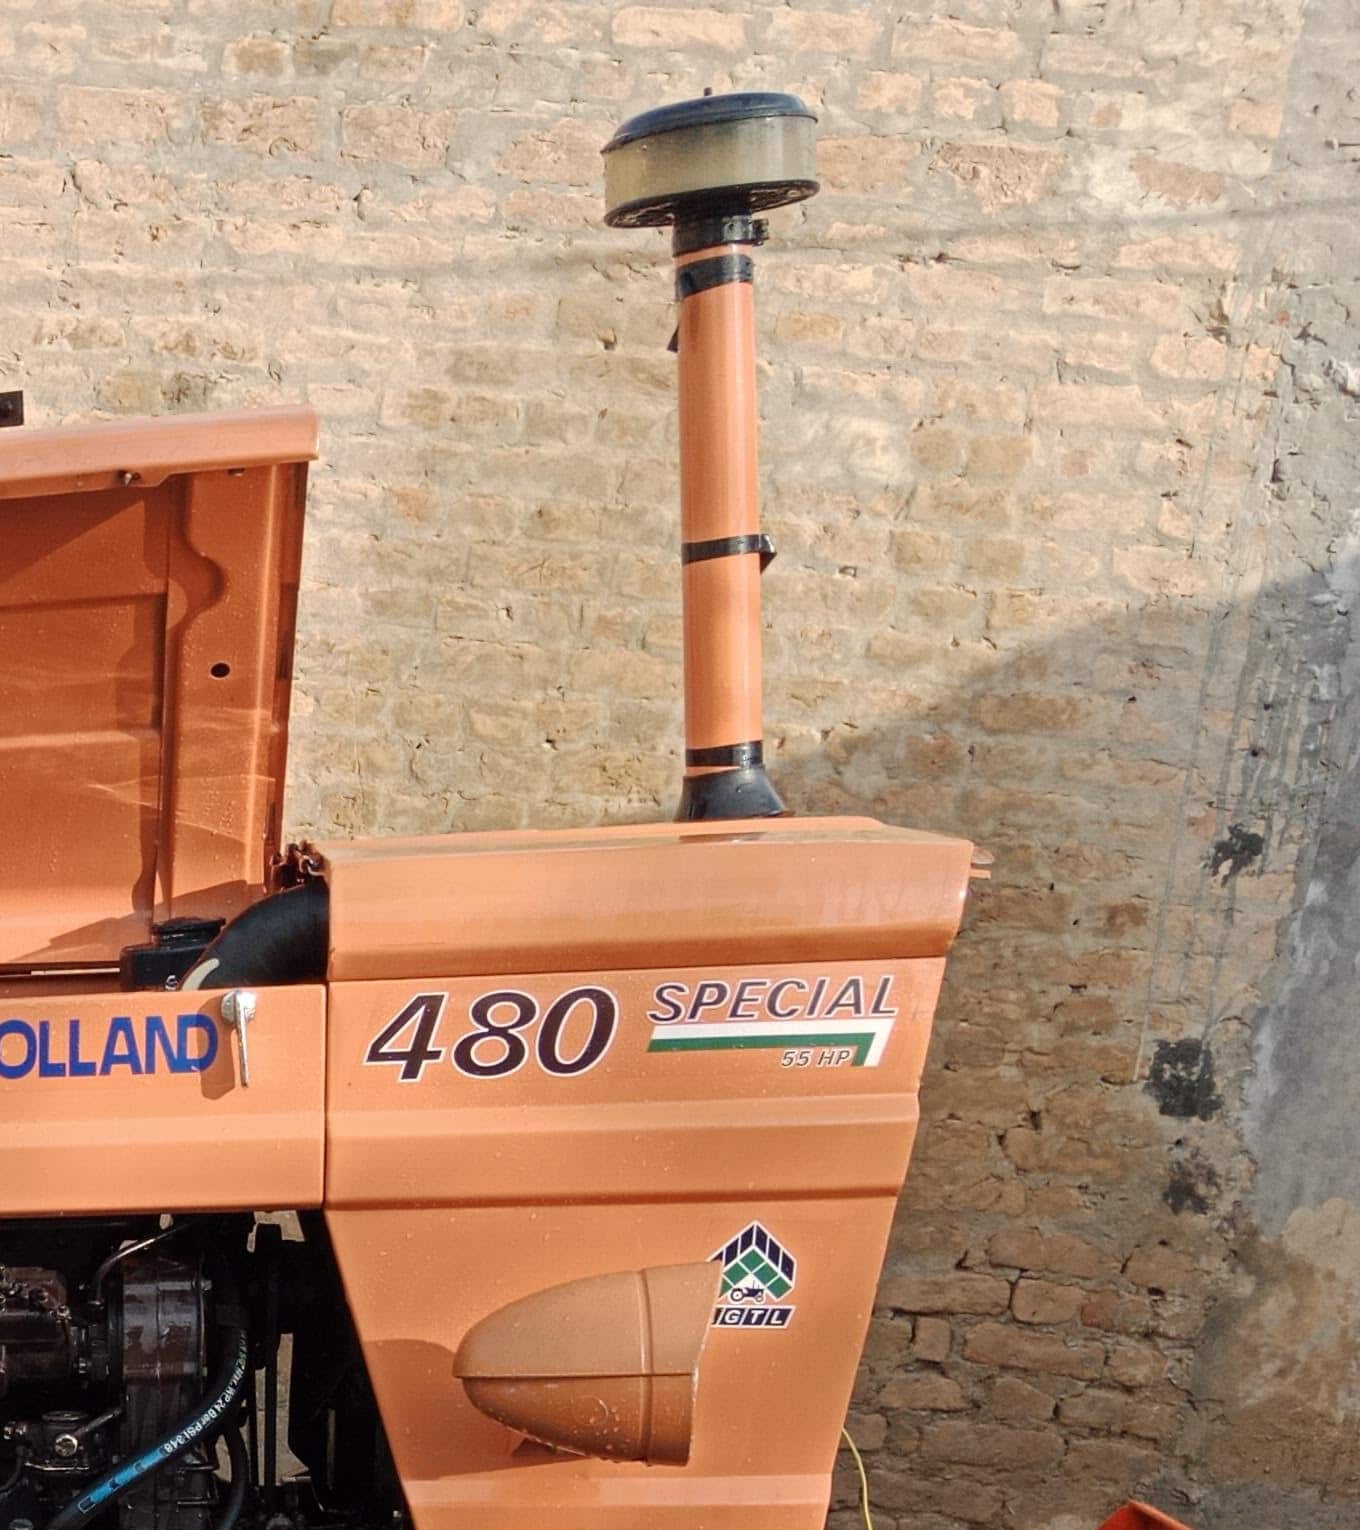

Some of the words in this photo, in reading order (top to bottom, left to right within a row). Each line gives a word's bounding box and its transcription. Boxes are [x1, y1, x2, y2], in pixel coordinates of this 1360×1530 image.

[647, 975, 899, 1022] SPECIAL
[365, 985, 619, 1082] 480
[781, 1050, 812, 1068] 55
[817, 1049, 851, 1067] HP
